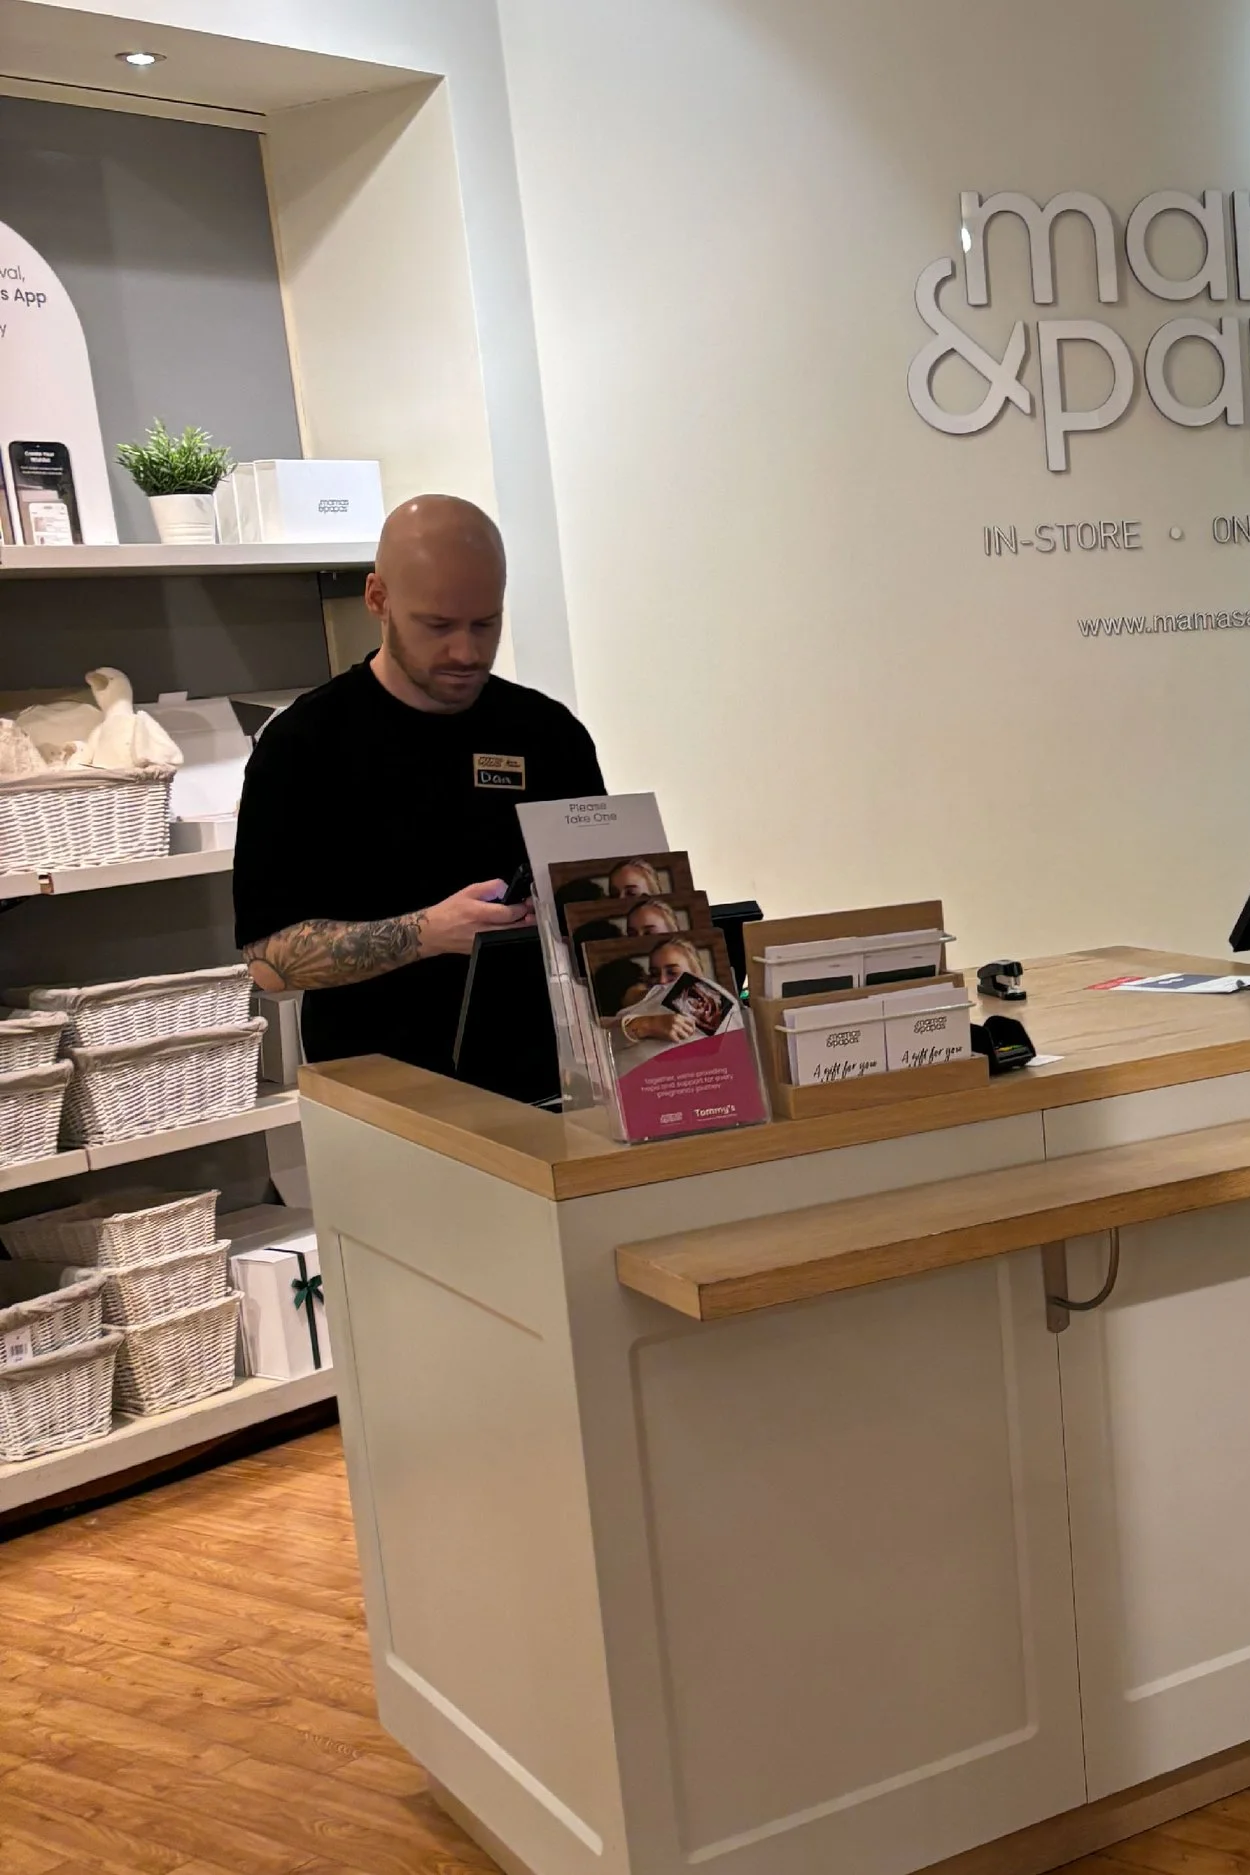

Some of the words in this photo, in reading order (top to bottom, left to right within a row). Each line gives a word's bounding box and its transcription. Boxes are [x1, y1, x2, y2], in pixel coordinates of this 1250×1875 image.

[14, 288, 47, 308] App
[983, 519, 1143, 556] IN-STORE
[569, 802, 607, 813] Please
[565, 814, 592, 825] Take
[593, 812, 618, 823] One
[901, 1050, 909, 1064] A
[908, 1047, 929, 1068] gift
[928, 1045, 944, 1065] for
[813, 1063, 820, 1079] A
[820, 1061, 841, 1082] gift
[841, 1060, 857, 1079] for
[694, 1104, 736, 1118] Tommy's
